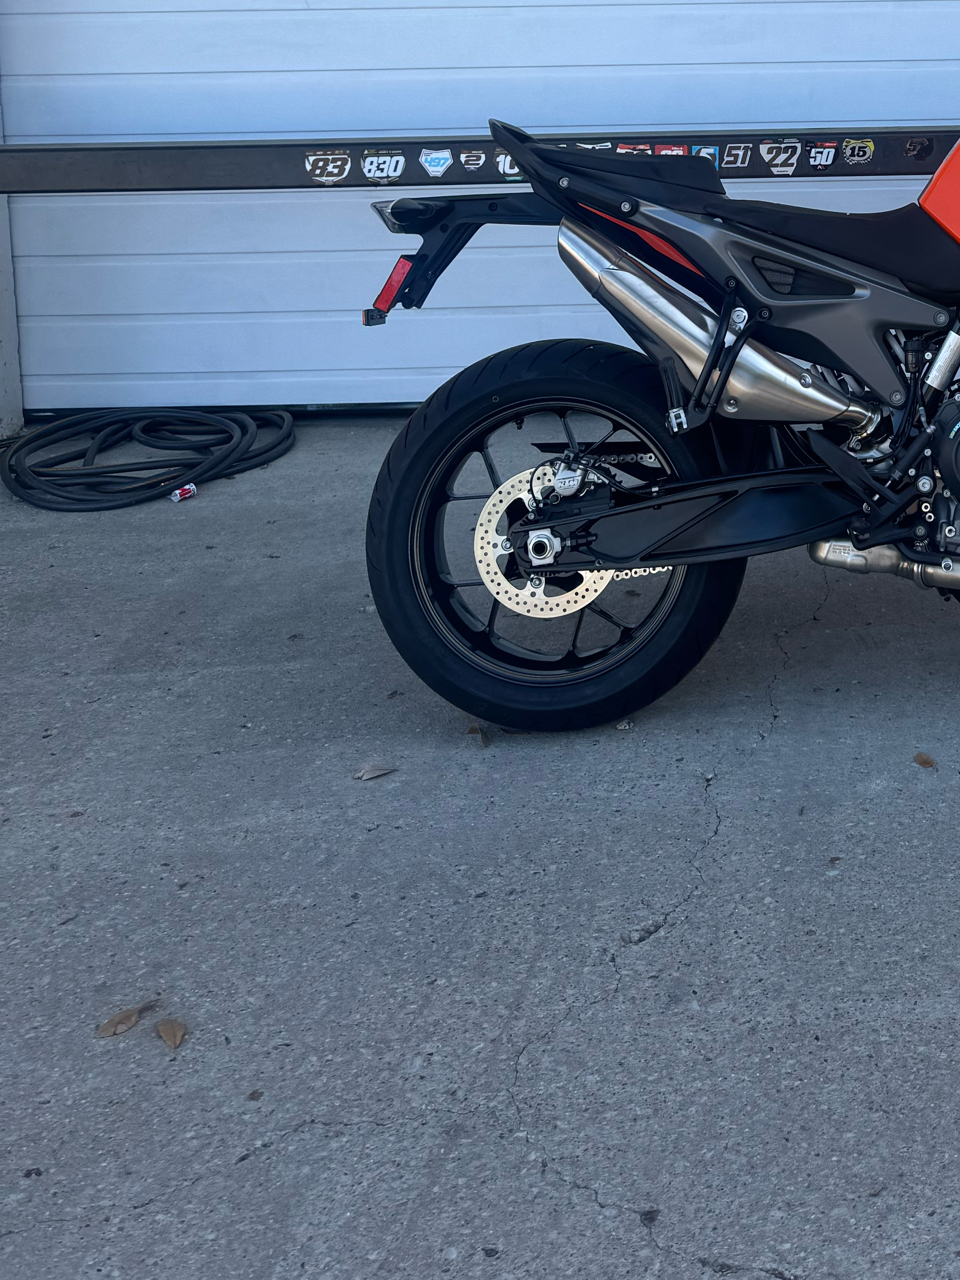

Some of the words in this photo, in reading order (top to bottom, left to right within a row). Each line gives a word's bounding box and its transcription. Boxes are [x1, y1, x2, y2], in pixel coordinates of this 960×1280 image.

[464, 154, 482, 167] 2
[722, 144, 753, 168] 51
[766, 145, 798, 168] 22
[809, 148, 836, 166] 50
[849, 146, 867, 158] 15
[308, 156, 349, 177] 83
[363, 155, 405, 177] 830
[424, 157, 450, 168] 497
